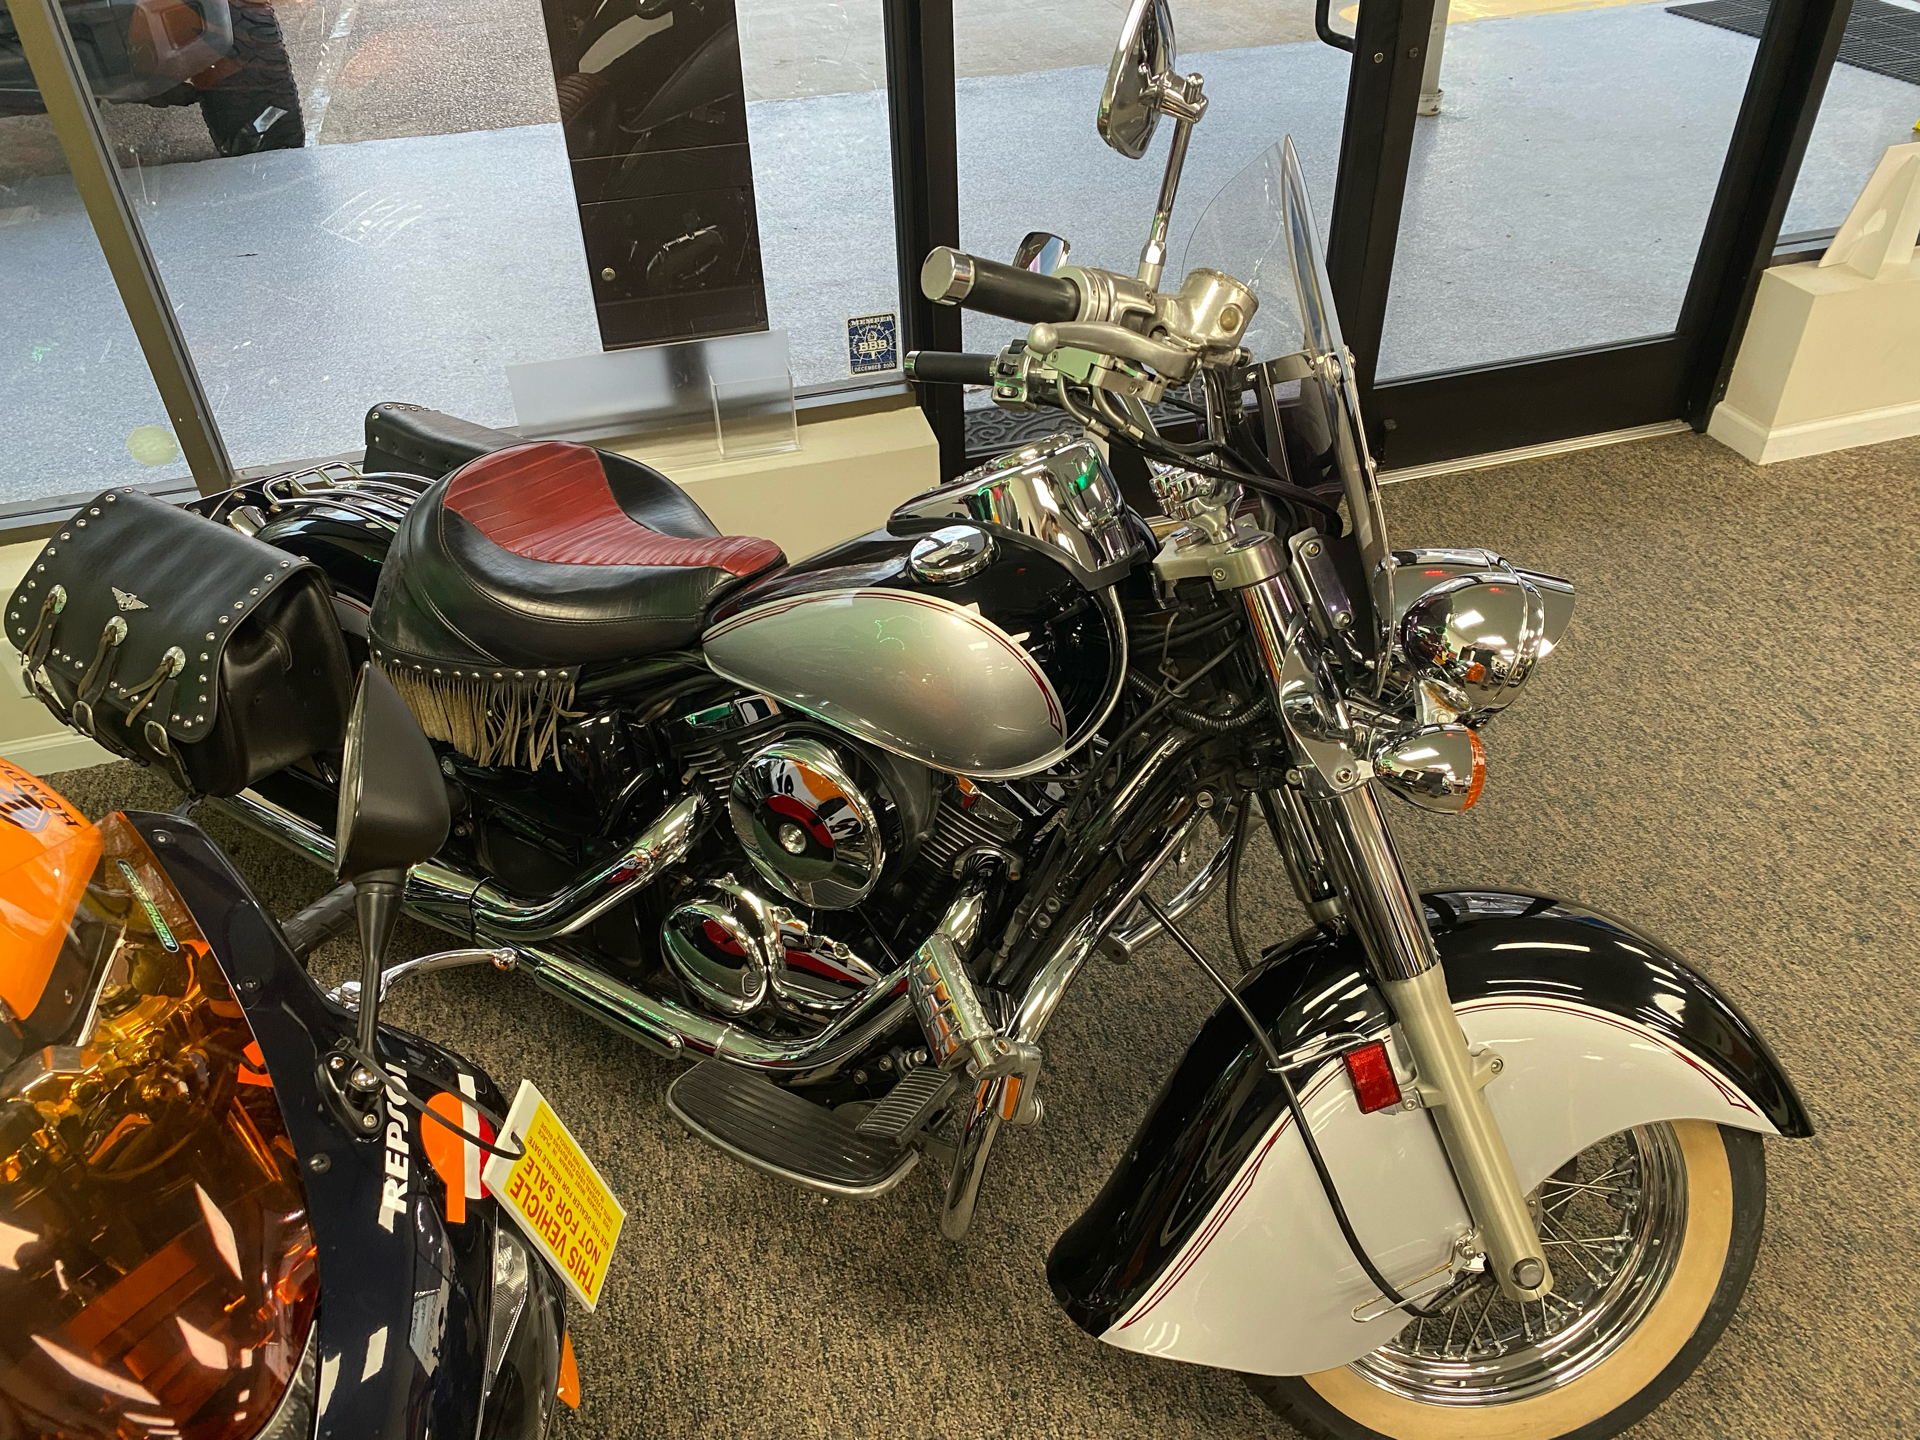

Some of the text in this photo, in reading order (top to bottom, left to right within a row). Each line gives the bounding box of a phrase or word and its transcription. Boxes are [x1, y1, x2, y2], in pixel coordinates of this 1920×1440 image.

[851, 315, 892, 325] MEMBER
[859, 340, 887, 351] BBB
[854, 364, 881, 372] DECEMBER
[378, 1059, 410, 1234] REPSOL
[536, 1126, 551, 1148] PLACE
[522, 1154, 556, 1205] SALE
[566, 1157, 576, 1173] CAR
[526, 1134, 610, 1251] SEE THE DEALER FOR RESALE DATE
[509, 1170, 597, 1296] THIS VEHICLE
[554, 1195, 580, 1236] FOR
[577, 1227, 601, 1266] NOT
